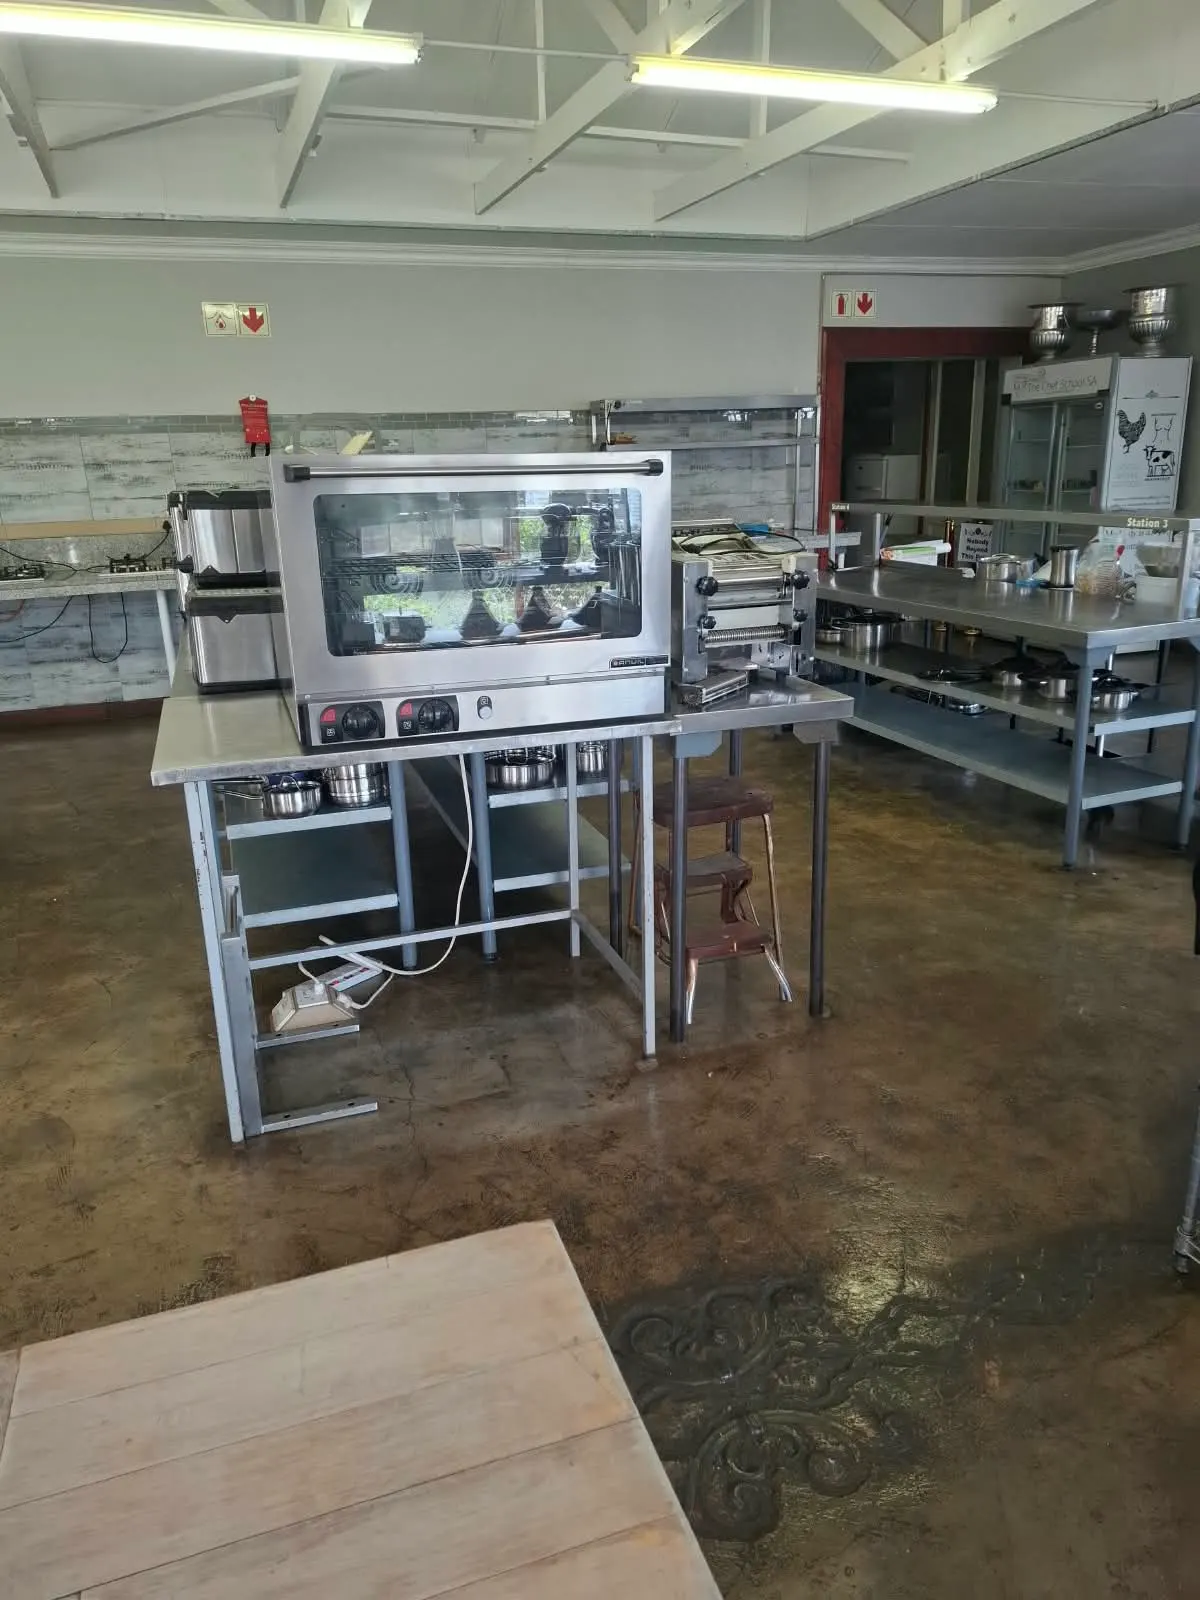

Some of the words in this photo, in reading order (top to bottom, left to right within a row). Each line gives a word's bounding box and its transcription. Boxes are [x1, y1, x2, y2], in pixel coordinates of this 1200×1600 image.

[1127, 517, 1160, 528] Station
[1162, 519, 1169, 528] 3
[966, 537, 989, 546] Nobody
